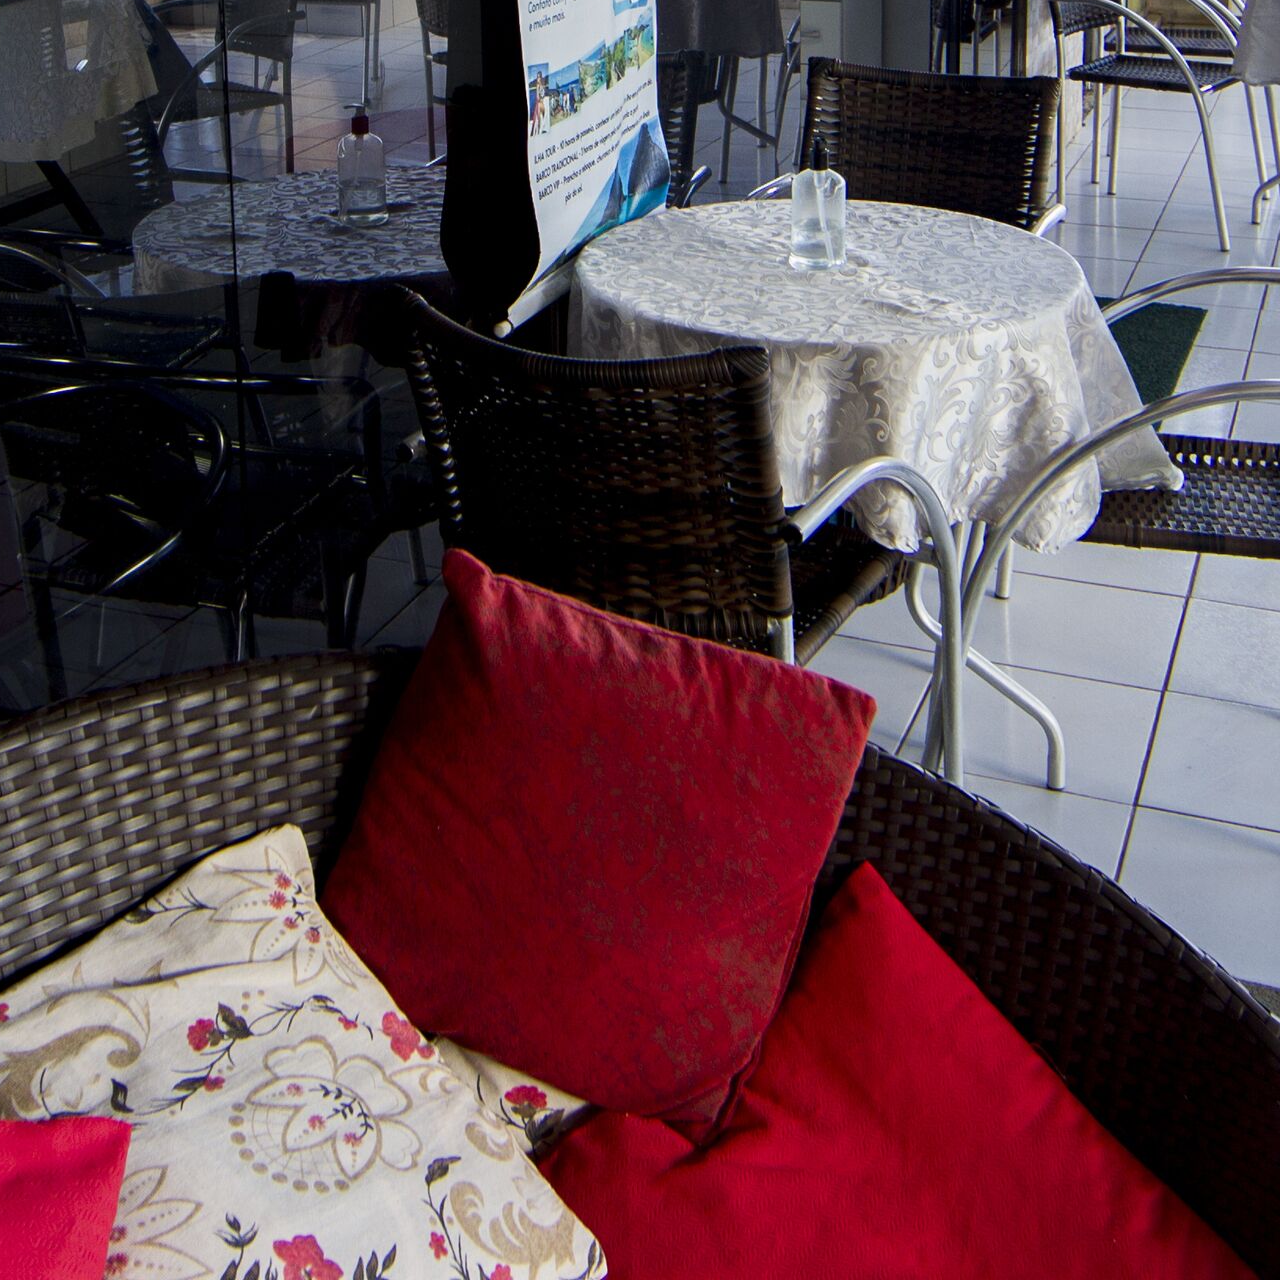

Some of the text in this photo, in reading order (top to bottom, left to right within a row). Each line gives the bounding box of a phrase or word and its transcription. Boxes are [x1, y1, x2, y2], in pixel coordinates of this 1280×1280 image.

[533, 14, 551, 30] muito
[536, 166, 551, 183] BARCO
[538, 184, 553, 200] BARCO
